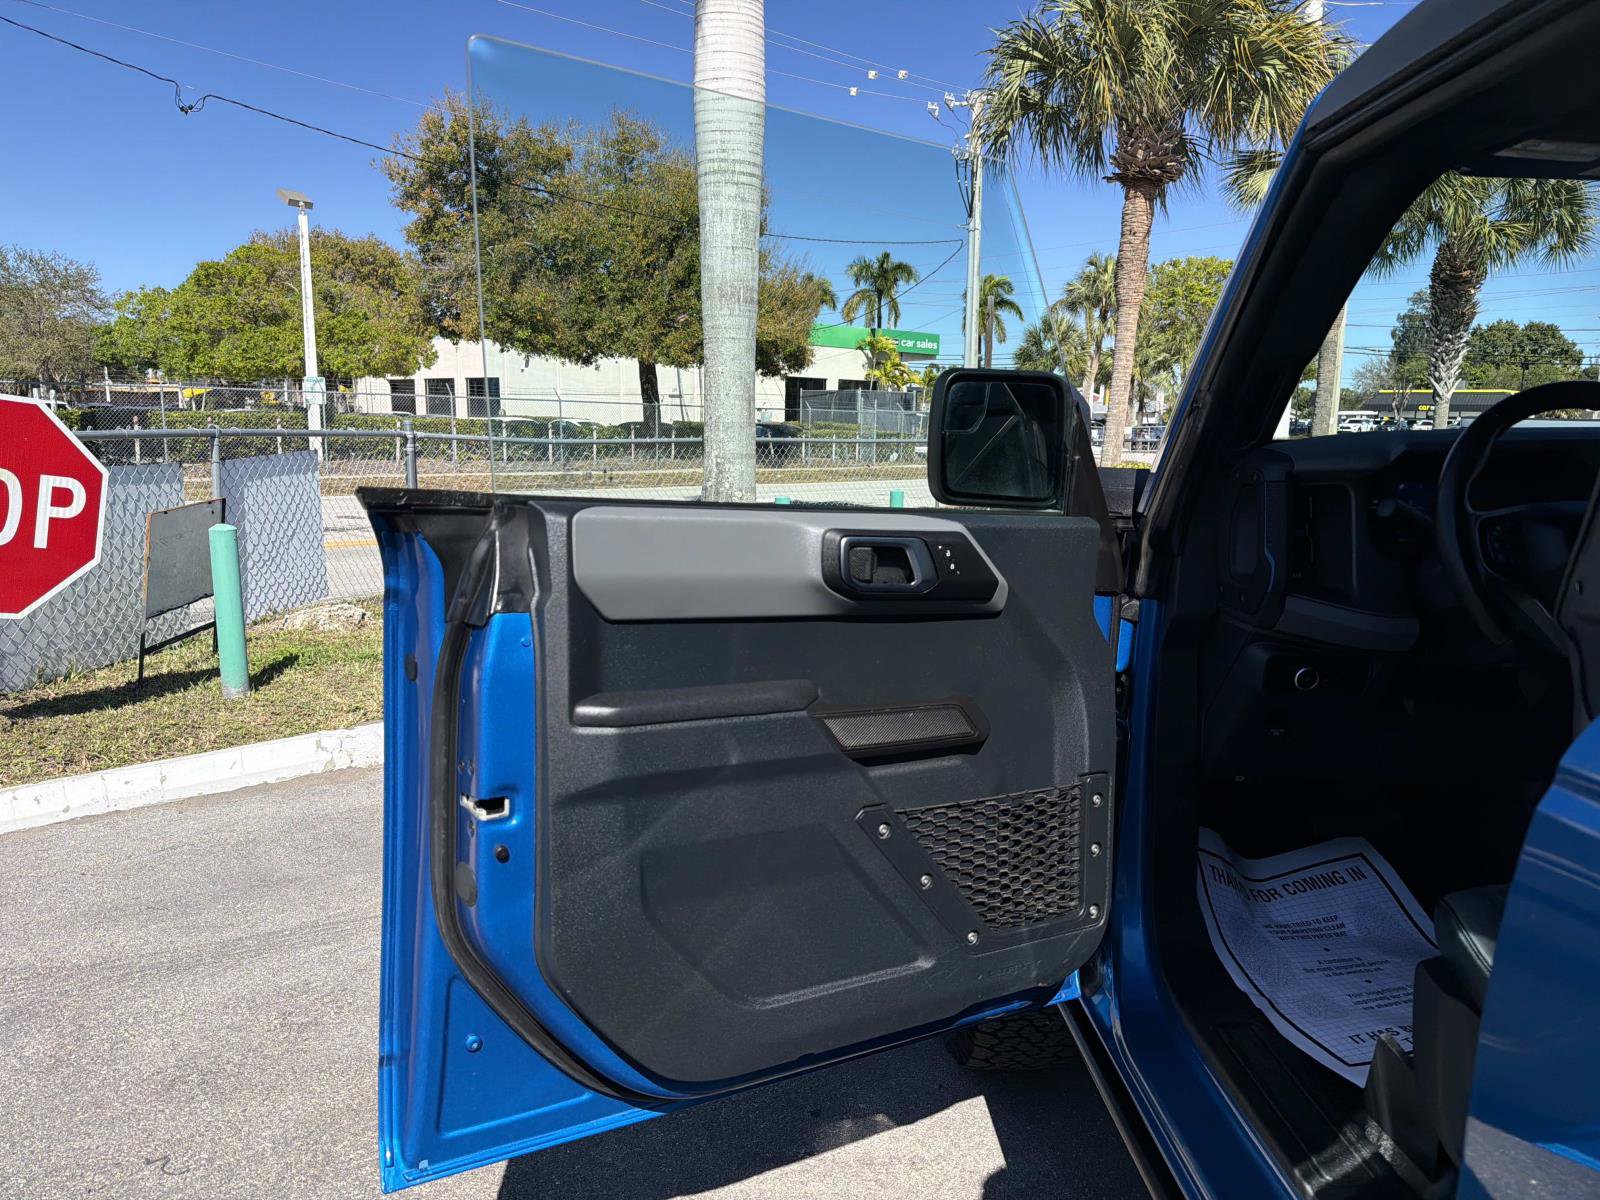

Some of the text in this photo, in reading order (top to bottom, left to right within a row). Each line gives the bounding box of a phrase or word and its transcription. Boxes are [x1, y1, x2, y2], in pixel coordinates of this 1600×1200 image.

[901, 339, 915, 348] car
[916, 338, 937, 350] sales
[1249, 888, 1284, 903] FOR
[1283, 870, 1346, 895] COMING
[1345, 866, 1367, 882] IN
[1348, 1033, 1366, 1044] IT
